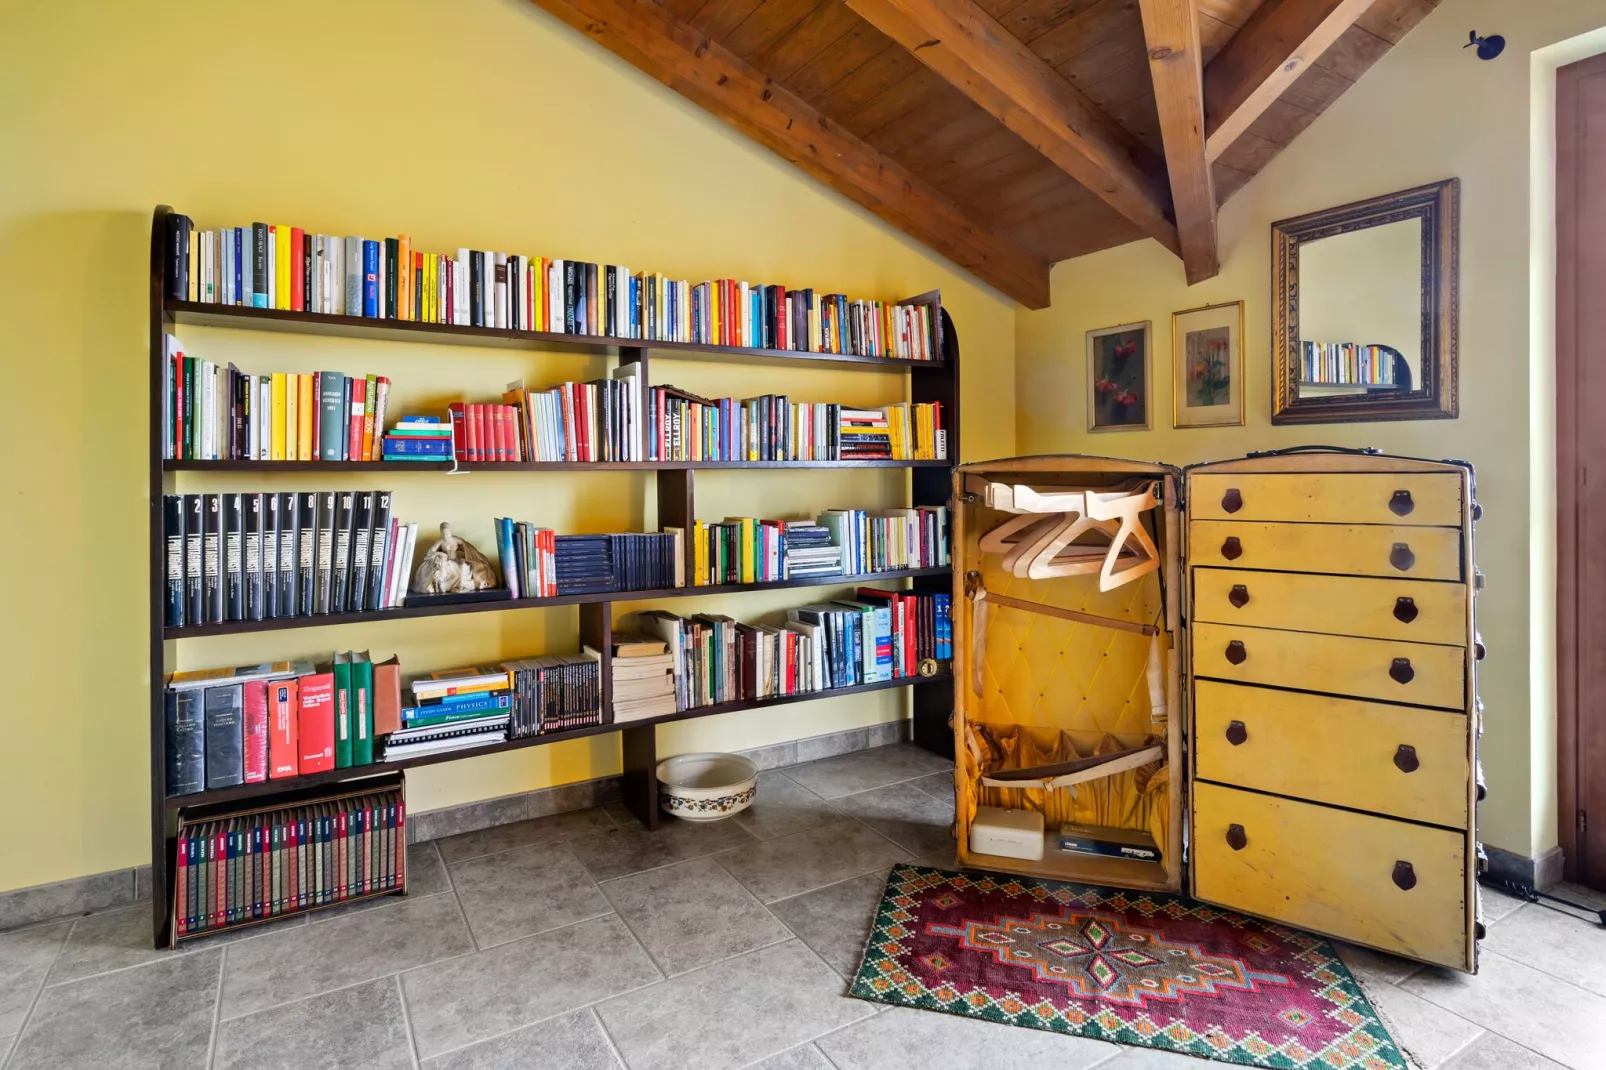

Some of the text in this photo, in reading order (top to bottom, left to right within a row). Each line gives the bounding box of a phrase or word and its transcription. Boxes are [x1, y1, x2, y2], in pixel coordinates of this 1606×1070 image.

[367, 380, 375, 413] Agriturismo
[364, 416, 373, 434] 2009
[177, 500, 181, 514] 1
[194, 498, 200, 513] 2
[212, 498, 218, 512] 3
[234, 497, 240, 510] 4
[253, 498, 259, 512] 5
[270, 497, 276, 511] 6
[288, 497, 293, 510] 7
[308, 496, 314, 508] 8
[328, 496, 333, 509] 9
[343, 496, 352, 509] 10
[364, 497, 371, 509] 11
[381, 496, 388, 508] 12
[456, 700, 488, 710] PHYSICS
